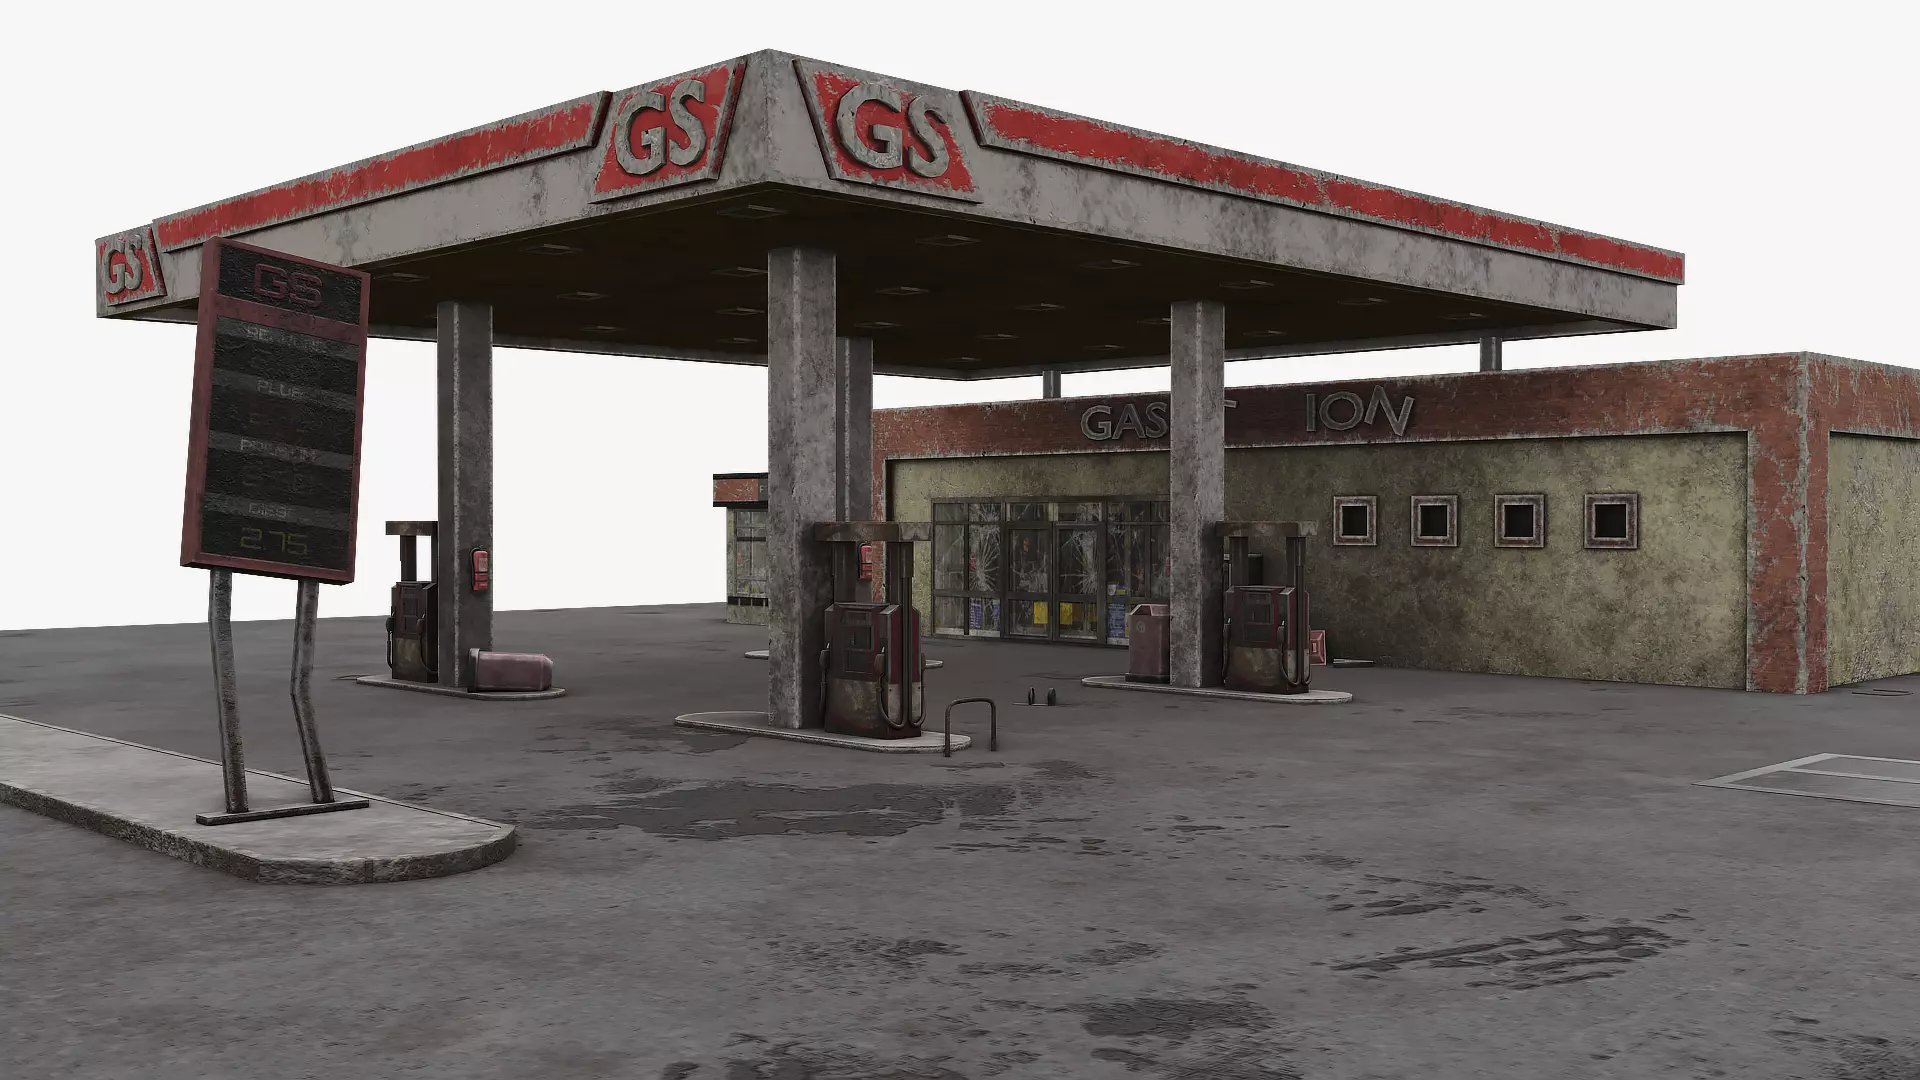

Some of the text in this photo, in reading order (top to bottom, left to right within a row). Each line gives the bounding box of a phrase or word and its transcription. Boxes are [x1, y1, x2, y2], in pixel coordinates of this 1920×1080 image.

[614, 80, 706, 175] GS
[836, 84, 948, 177] GS
[102, 233, 143, 294] GS
[253, 262, 323, 308] GS
[1080, 402, 1169, 441] GAS
[1306, 385, 1415, 437] ION
